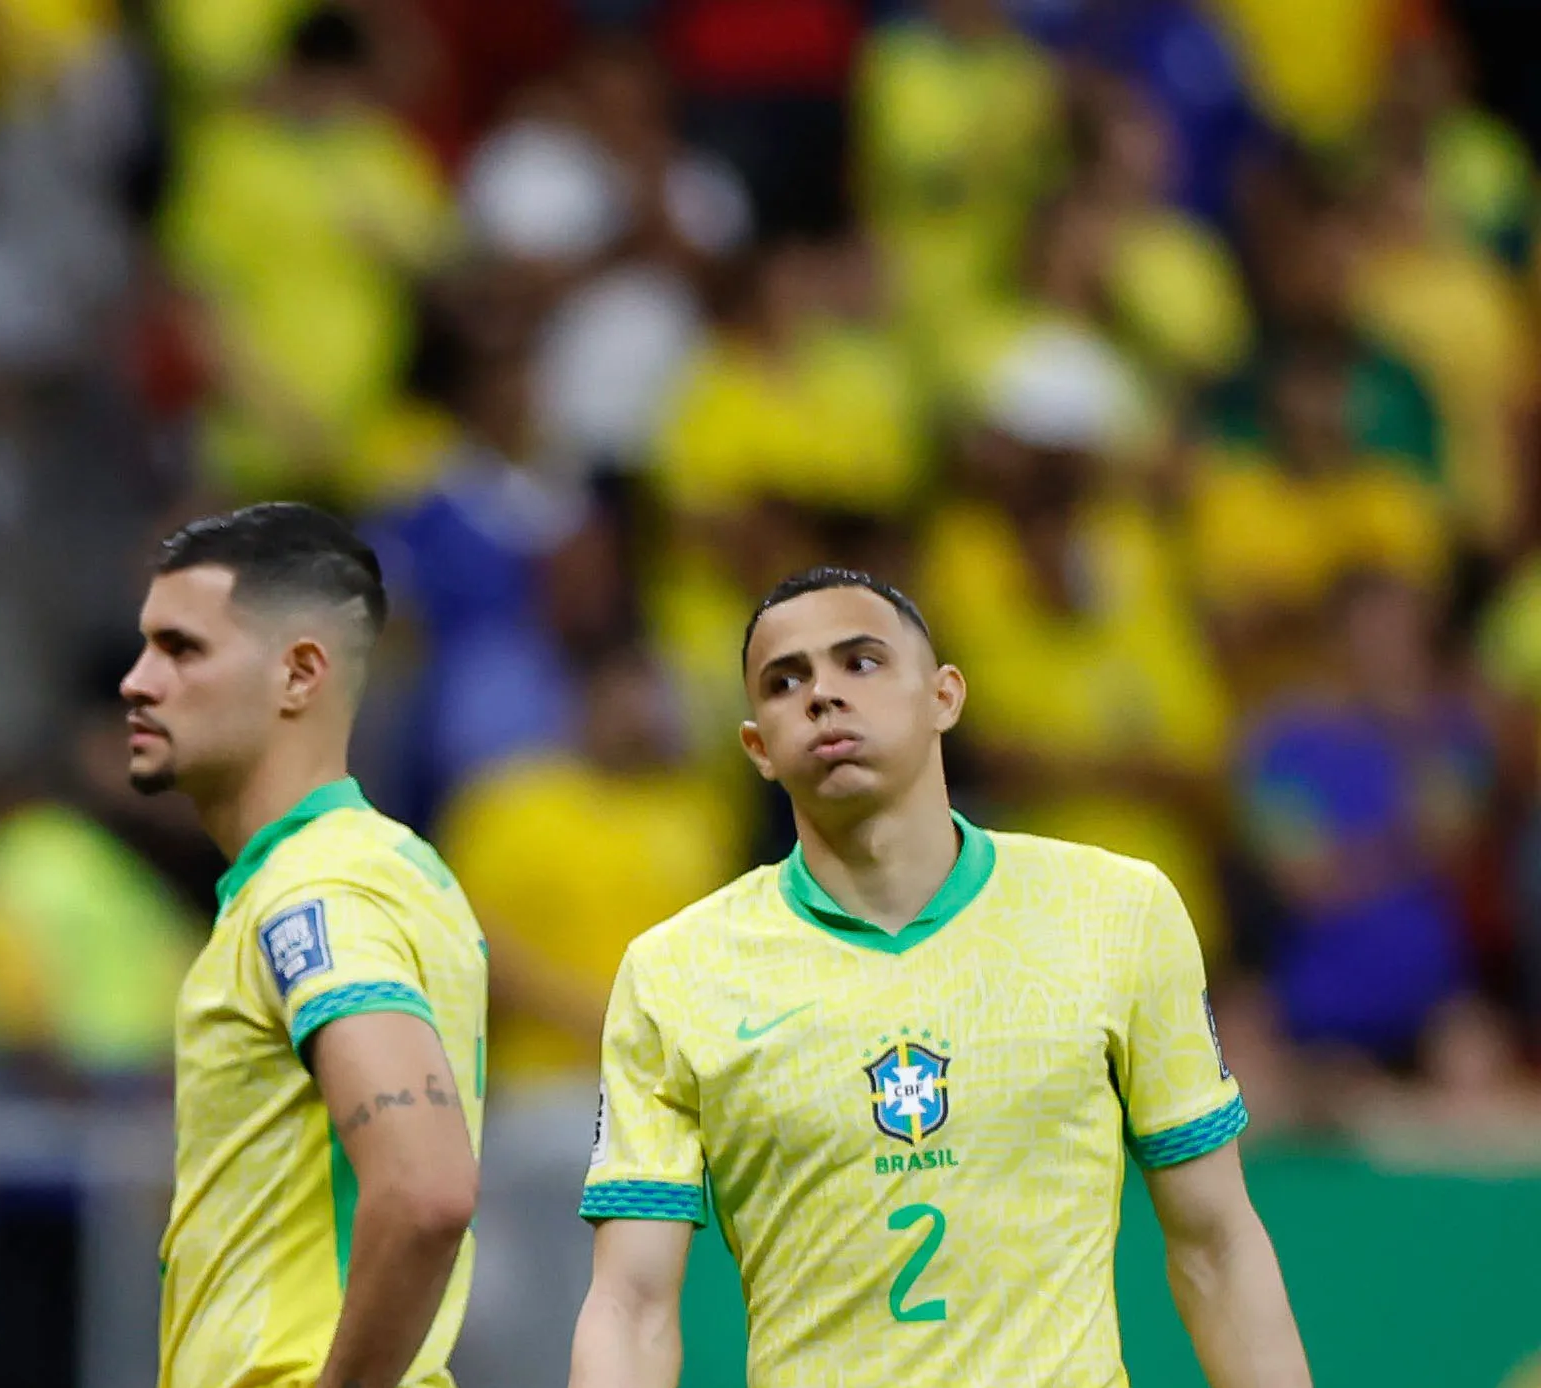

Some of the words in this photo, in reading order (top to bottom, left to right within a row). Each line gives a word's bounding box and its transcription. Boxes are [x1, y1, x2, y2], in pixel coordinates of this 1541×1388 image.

[893, 1081, 925, 1098] CBF
[874, 1148, 959, 1176] BRASIL
[886, 1202, 948, 1323] 2
